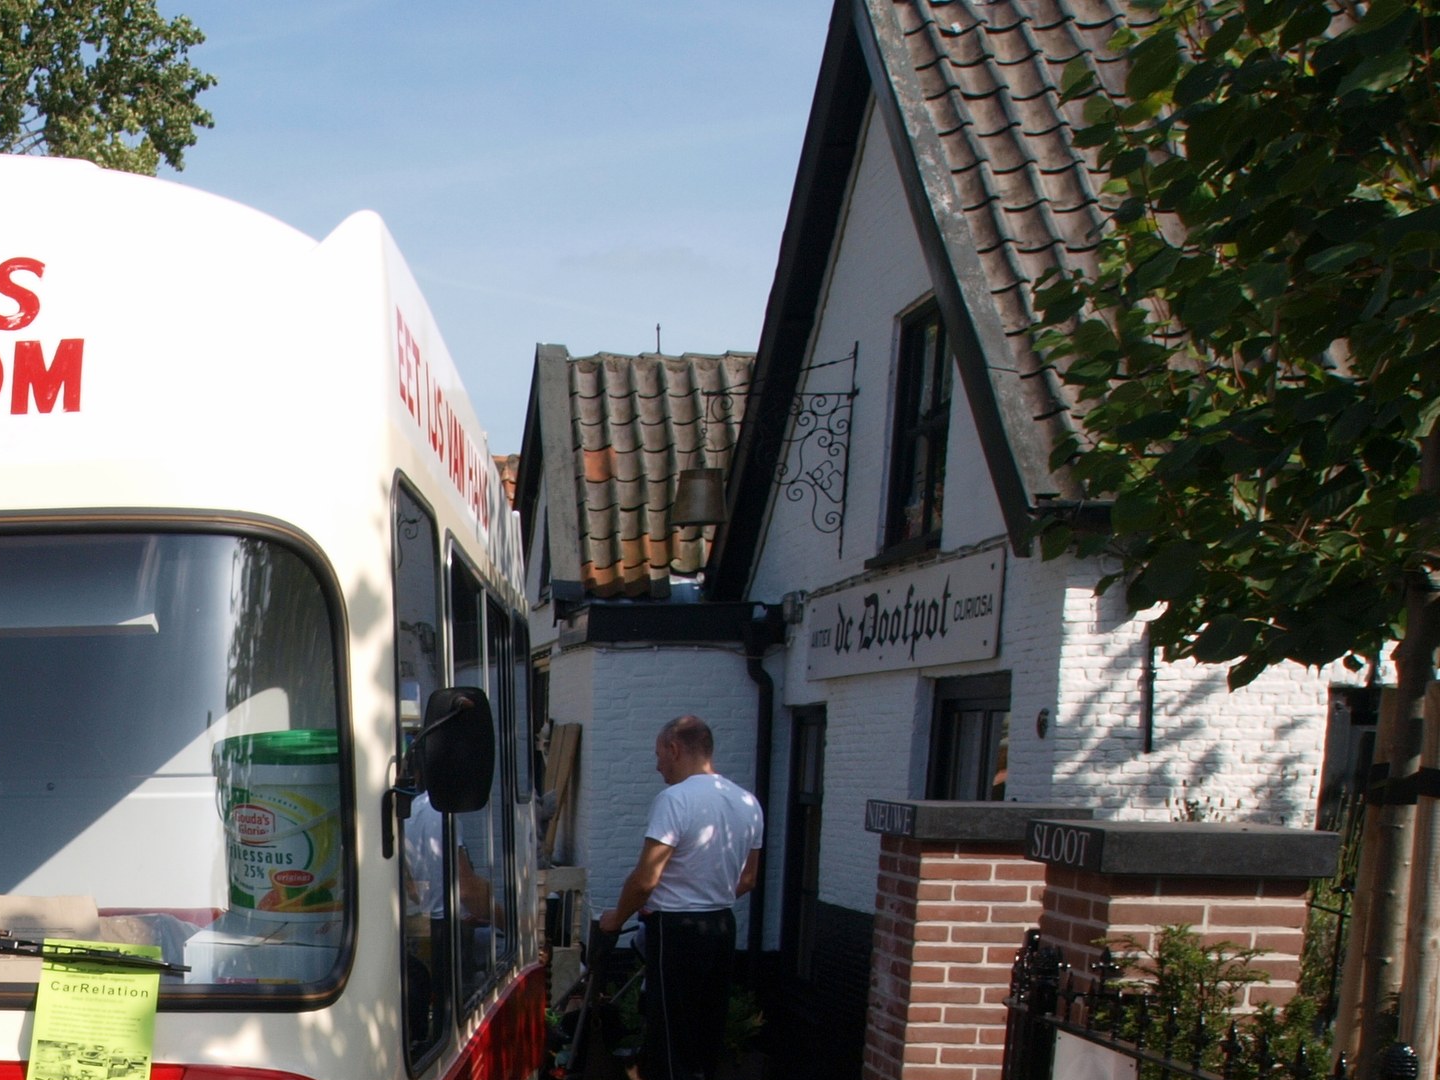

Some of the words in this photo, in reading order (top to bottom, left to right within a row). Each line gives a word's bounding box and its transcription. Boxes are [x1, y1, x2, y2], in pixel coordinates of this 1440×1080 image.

[396, 304, 421, 428] EET
[446, 401, 465, 498] VAN
[834, 603, 853, 655] de
[953, 593, 993, 622] CURIOSA
[868, 802, 912, 834] NIEUWE
[1032, 823, 1091, 867] SLOOT
[244, 864, 264, 879] 25%
[50, 981, 149, 998] CarRelation
